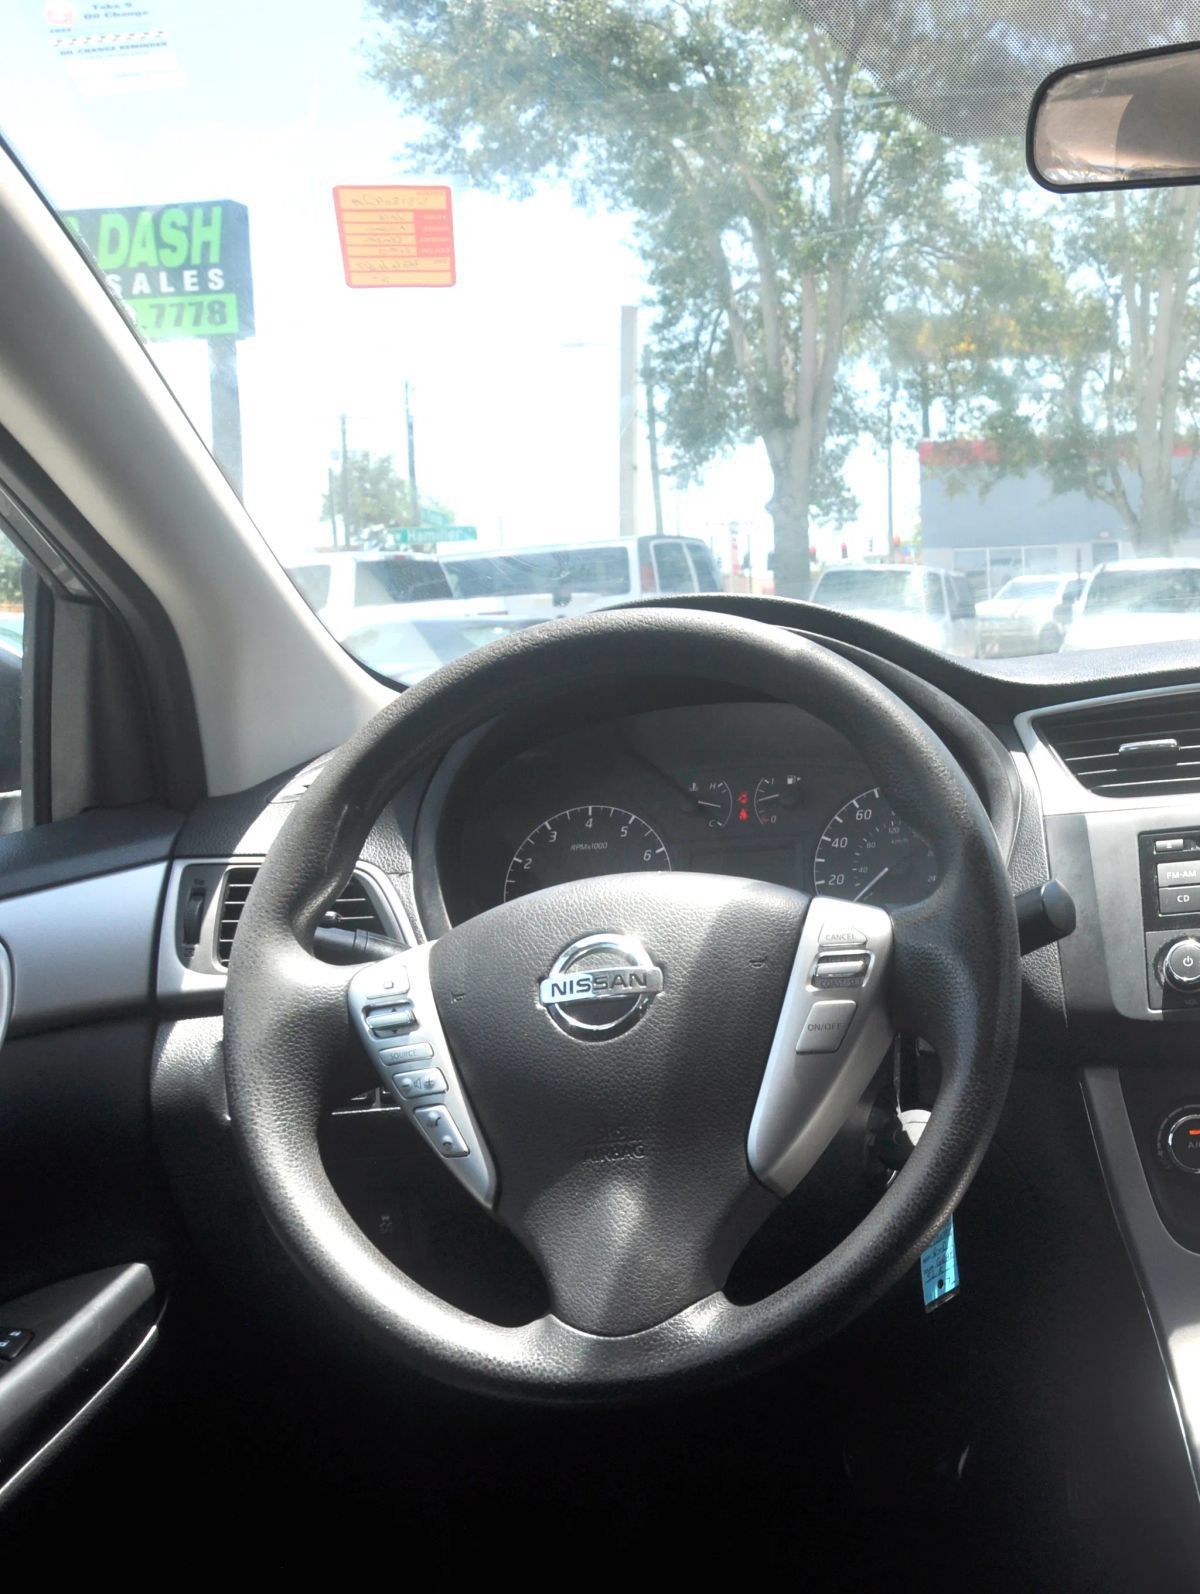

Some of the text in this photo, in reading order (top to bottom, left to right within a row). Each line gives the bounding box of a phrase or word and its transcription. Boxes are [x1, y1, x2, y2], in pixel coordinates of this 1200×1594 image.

[98, 205, 223, 270] DASH
[105, 268, 225, 299] SALES
[855, 808, 872, 821] 60
[584, 816, 594, 829] 4
[548, 830, 558, 843] 3
[619, 825, 629, 838] 5
[831, 836, 849, 849] 40
[642, 849, 652, 861] 6
[522, 858, 533, 870] 2
[828, 873, 845, 886] 20
[1176, 894, 1190, 903] CD
[825, 933, 857, 942] CANCEL
[550, 973, 648, 998] NISSAN
[807, 1021, 842, 1032] ON/OFF
[389, 1048, 418, 1060] SOURCE
